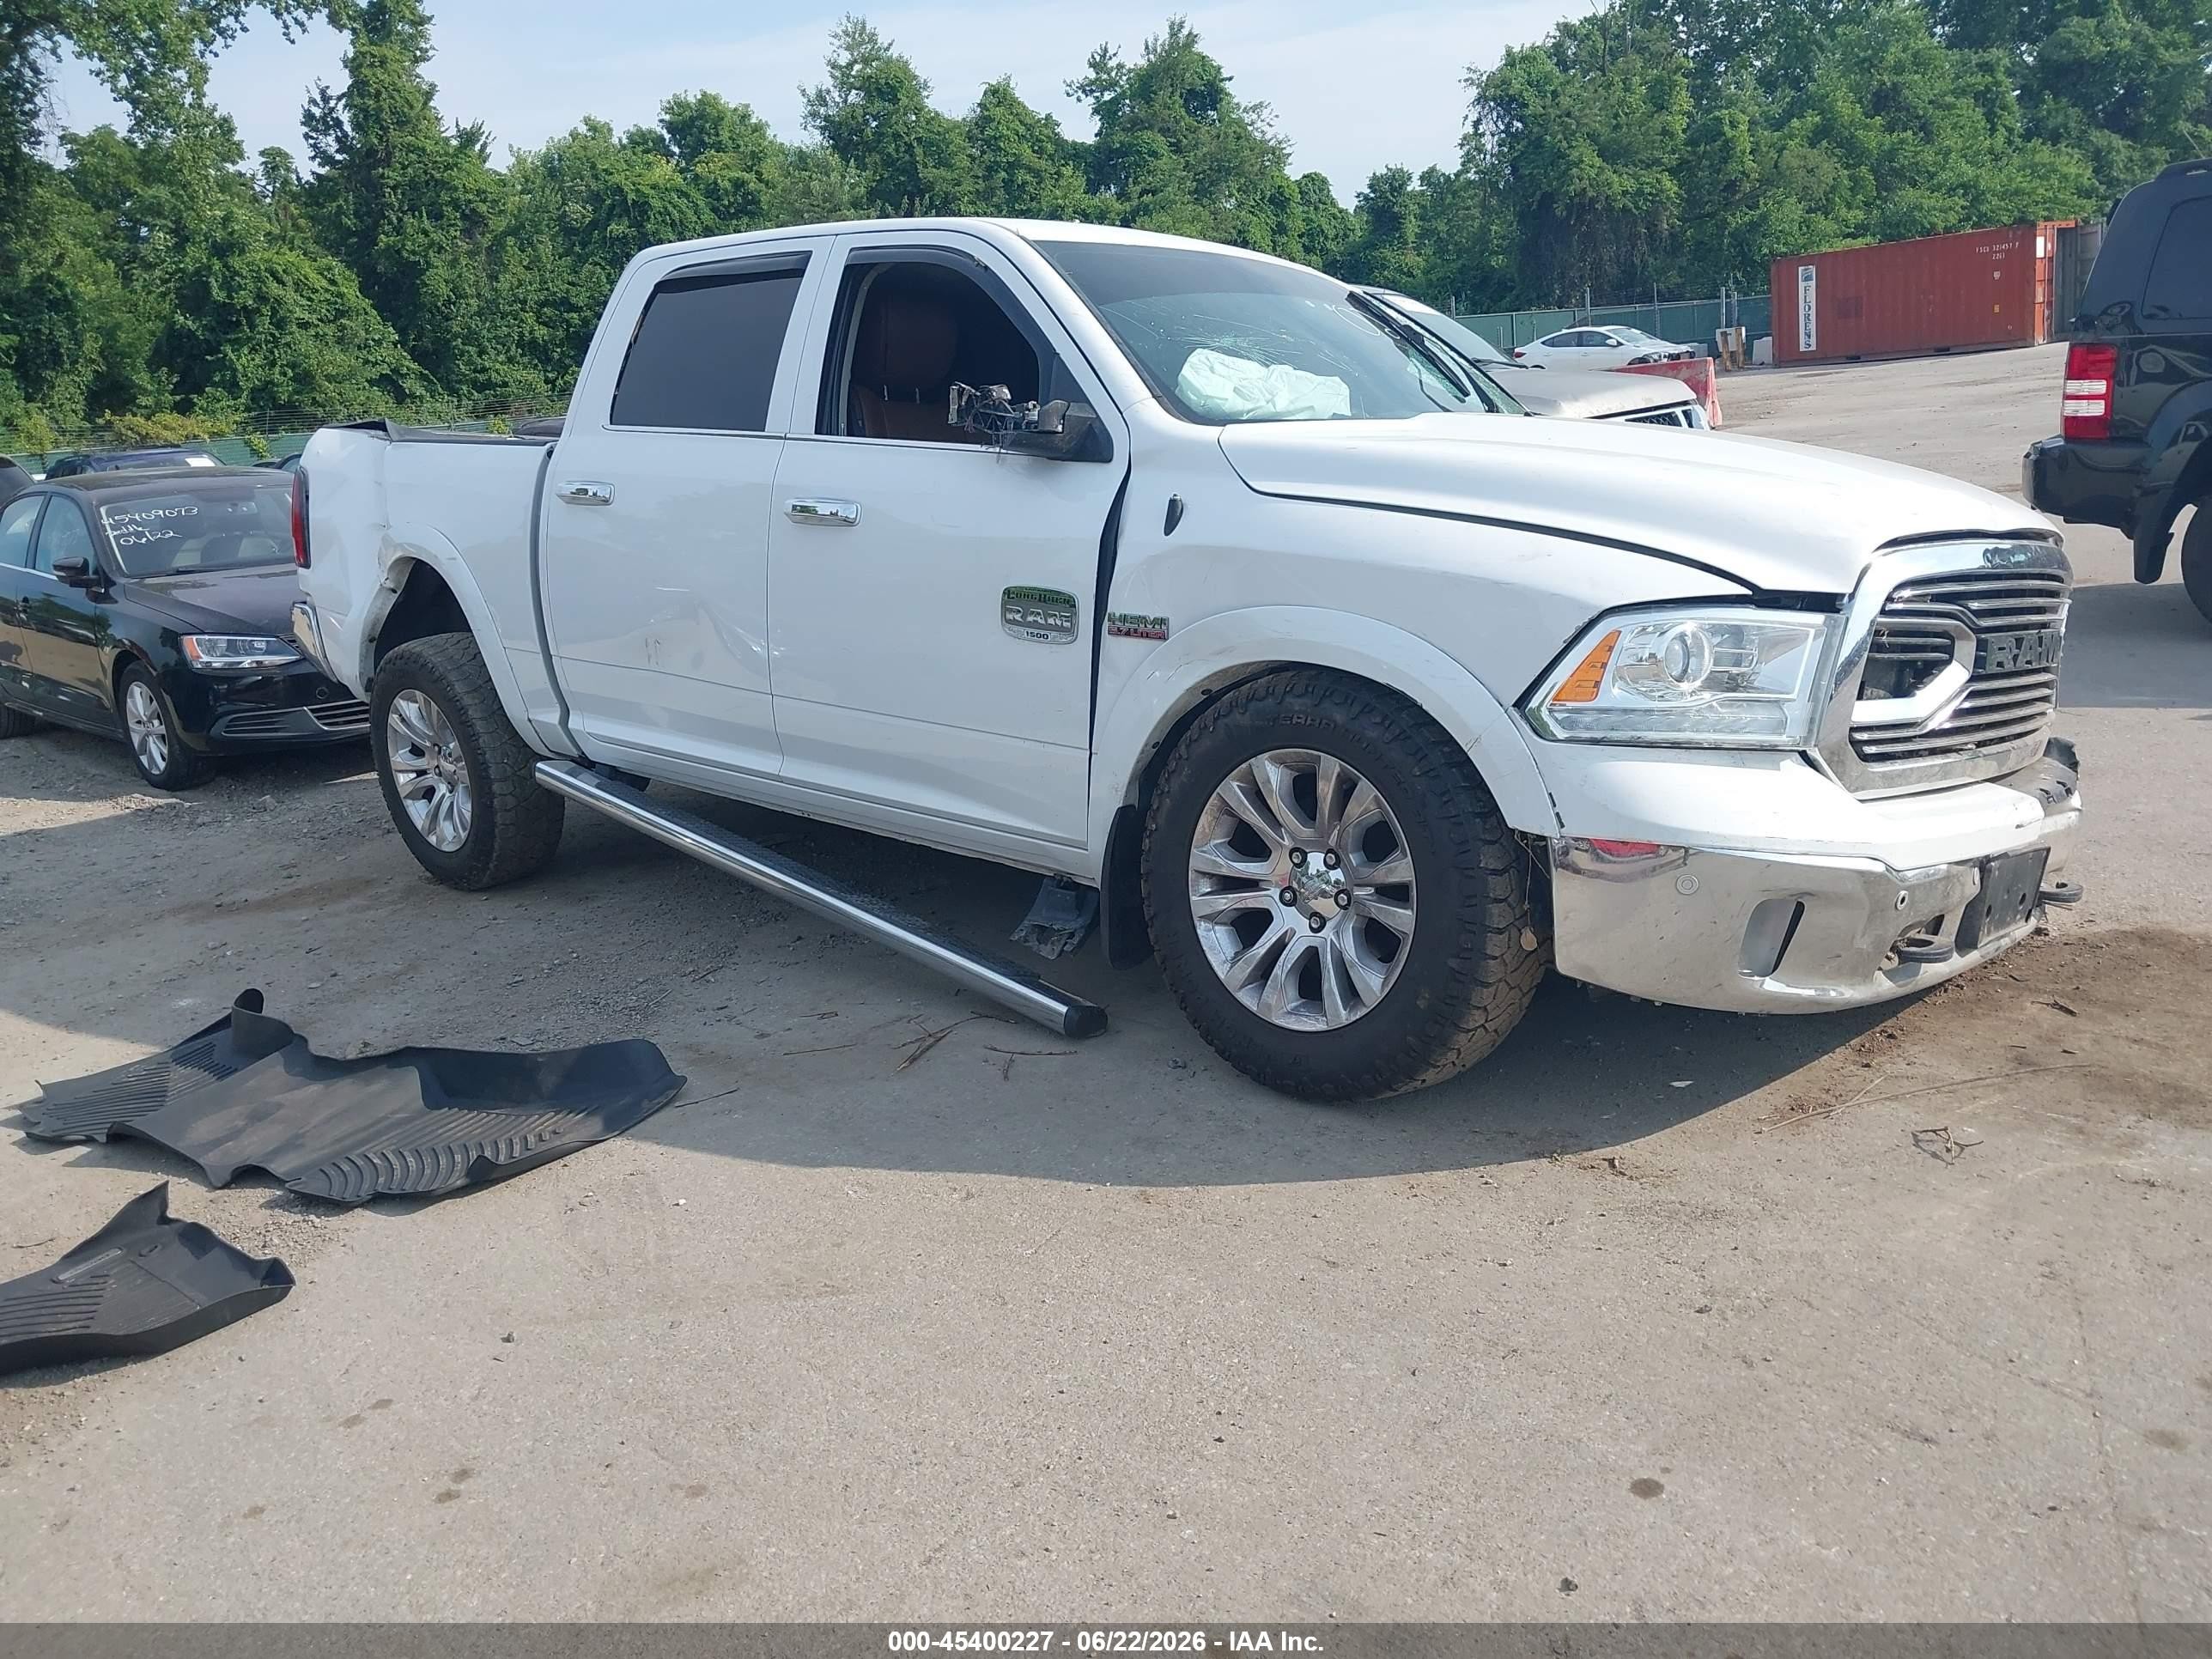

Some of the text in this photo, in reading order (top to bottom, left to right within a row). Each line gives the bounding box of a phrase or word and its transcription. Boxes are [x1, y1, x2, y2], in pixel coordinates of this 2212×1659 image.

[1803, 285, 1812, 349] FLORENS
[100, 506, 198, 525] 45409073
[1005, 605, 1073, 629] RAM
[1107, 611, 1170, 630] HEMI
[1025, 630, 1049, 640] 1500
[1985, 631, 2061, 674] RAM
